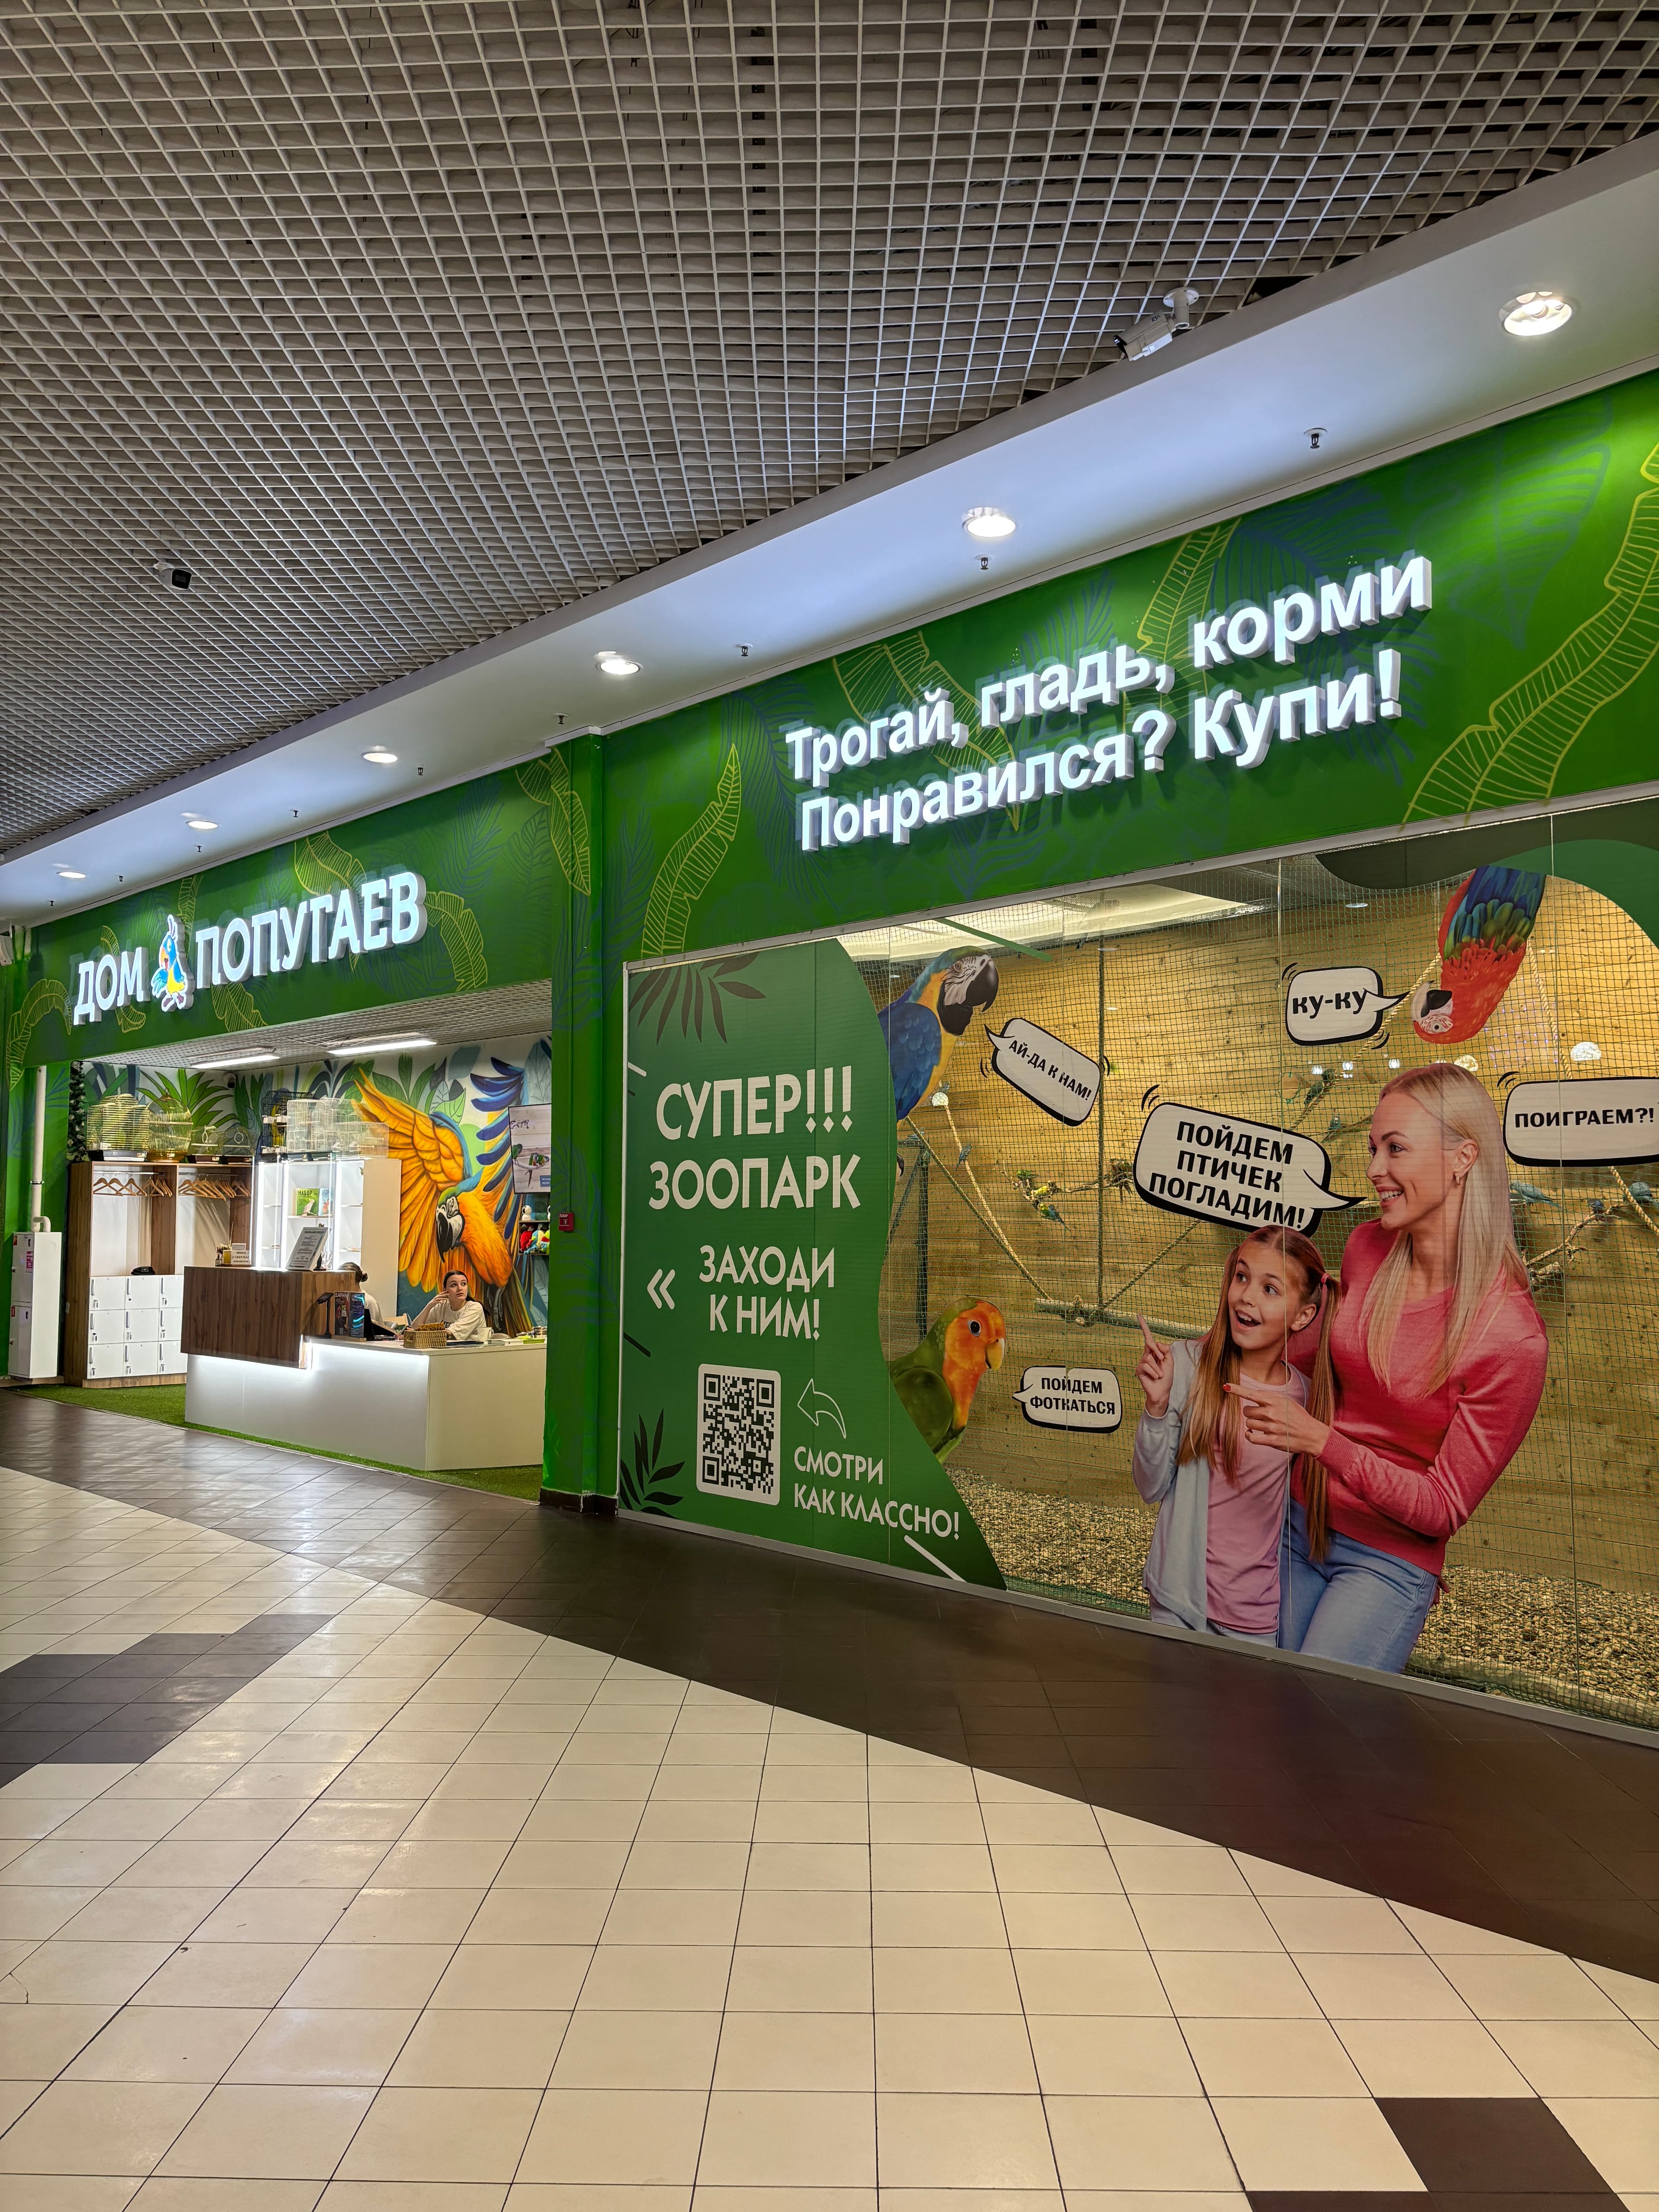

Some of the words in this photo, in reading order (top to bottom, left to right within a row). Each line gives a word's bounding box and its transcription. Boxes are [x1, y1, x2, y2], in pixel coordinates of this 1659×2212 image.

[785, 687, 969, 788] Трогай,
[981, 644, 1175, 729] гладь,
[1193, 556, 1432, 671] корми
[801, 709, 1177, 852] Понравился?
[1194, 648, 1402, 769] Купи!
[73, 947, 151, 1026] ДОМ
[195, 871, 428, 989] ПОПУГАЕВ
[1008, 1039, 1046, 1072] АЙ-ДА
[1048, 1065, 1059, 1079] К
[1058, 1073, 1092, 1101] НАМ!
[656, 1065, 853, 1141] СУПЕР!!!
[1515, 1107, 1655, 1128] ПОИГРАЕМ?!
[1176, 1121, 1294, 1165] ПОЙДЕМ
[648, 1154, 861, 1210] ЗООПАРК
[1176, 1150, 1283, 1193] ПТИЧЕК
[1148, 1172, 1306, 1230] ПОГЛАДИМ!
[699, 1244, 835, 1294] ЗАХОДИ
[709, 1294, 729, 1333] К
[736, 1295, 820, 1341] НИМ!
[1030, 1395, 1116, 1415] ФОТКАТЬСЯ
[1041, 1376, 1103, 1395] ПОЙДЕМ
[793, 1446, 884, 1485] СМОТРИ
[794, 1483, 836, 1516] КАК
[840, 1491, 960, 1541] КЛАССНО!
